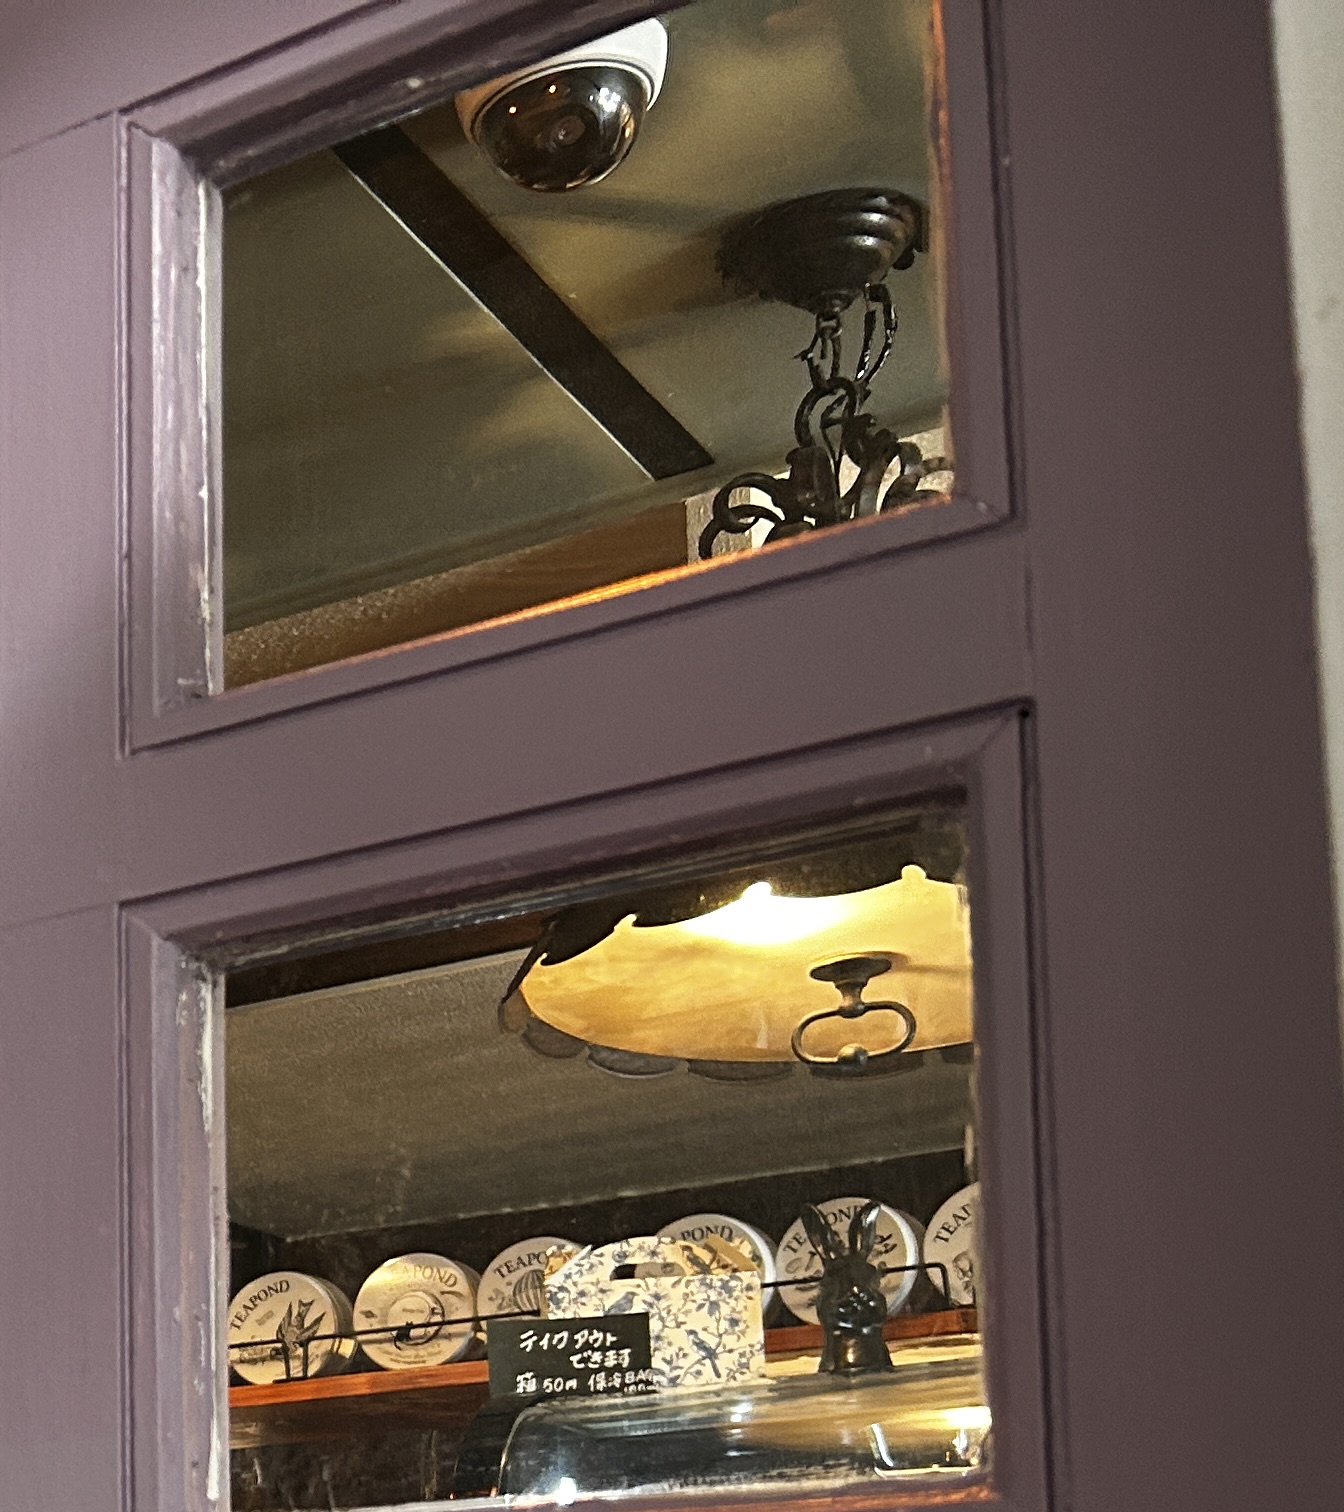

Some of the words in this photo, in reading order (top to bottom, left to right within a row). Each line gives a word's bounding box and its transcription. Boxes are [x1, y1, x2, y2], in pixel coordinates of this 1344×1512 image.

[493, 1250, 550, 1279] TEAPO
[229, 1279, 291, 1331] TEAPOND
[569, 1347, 632, 1369] できます
